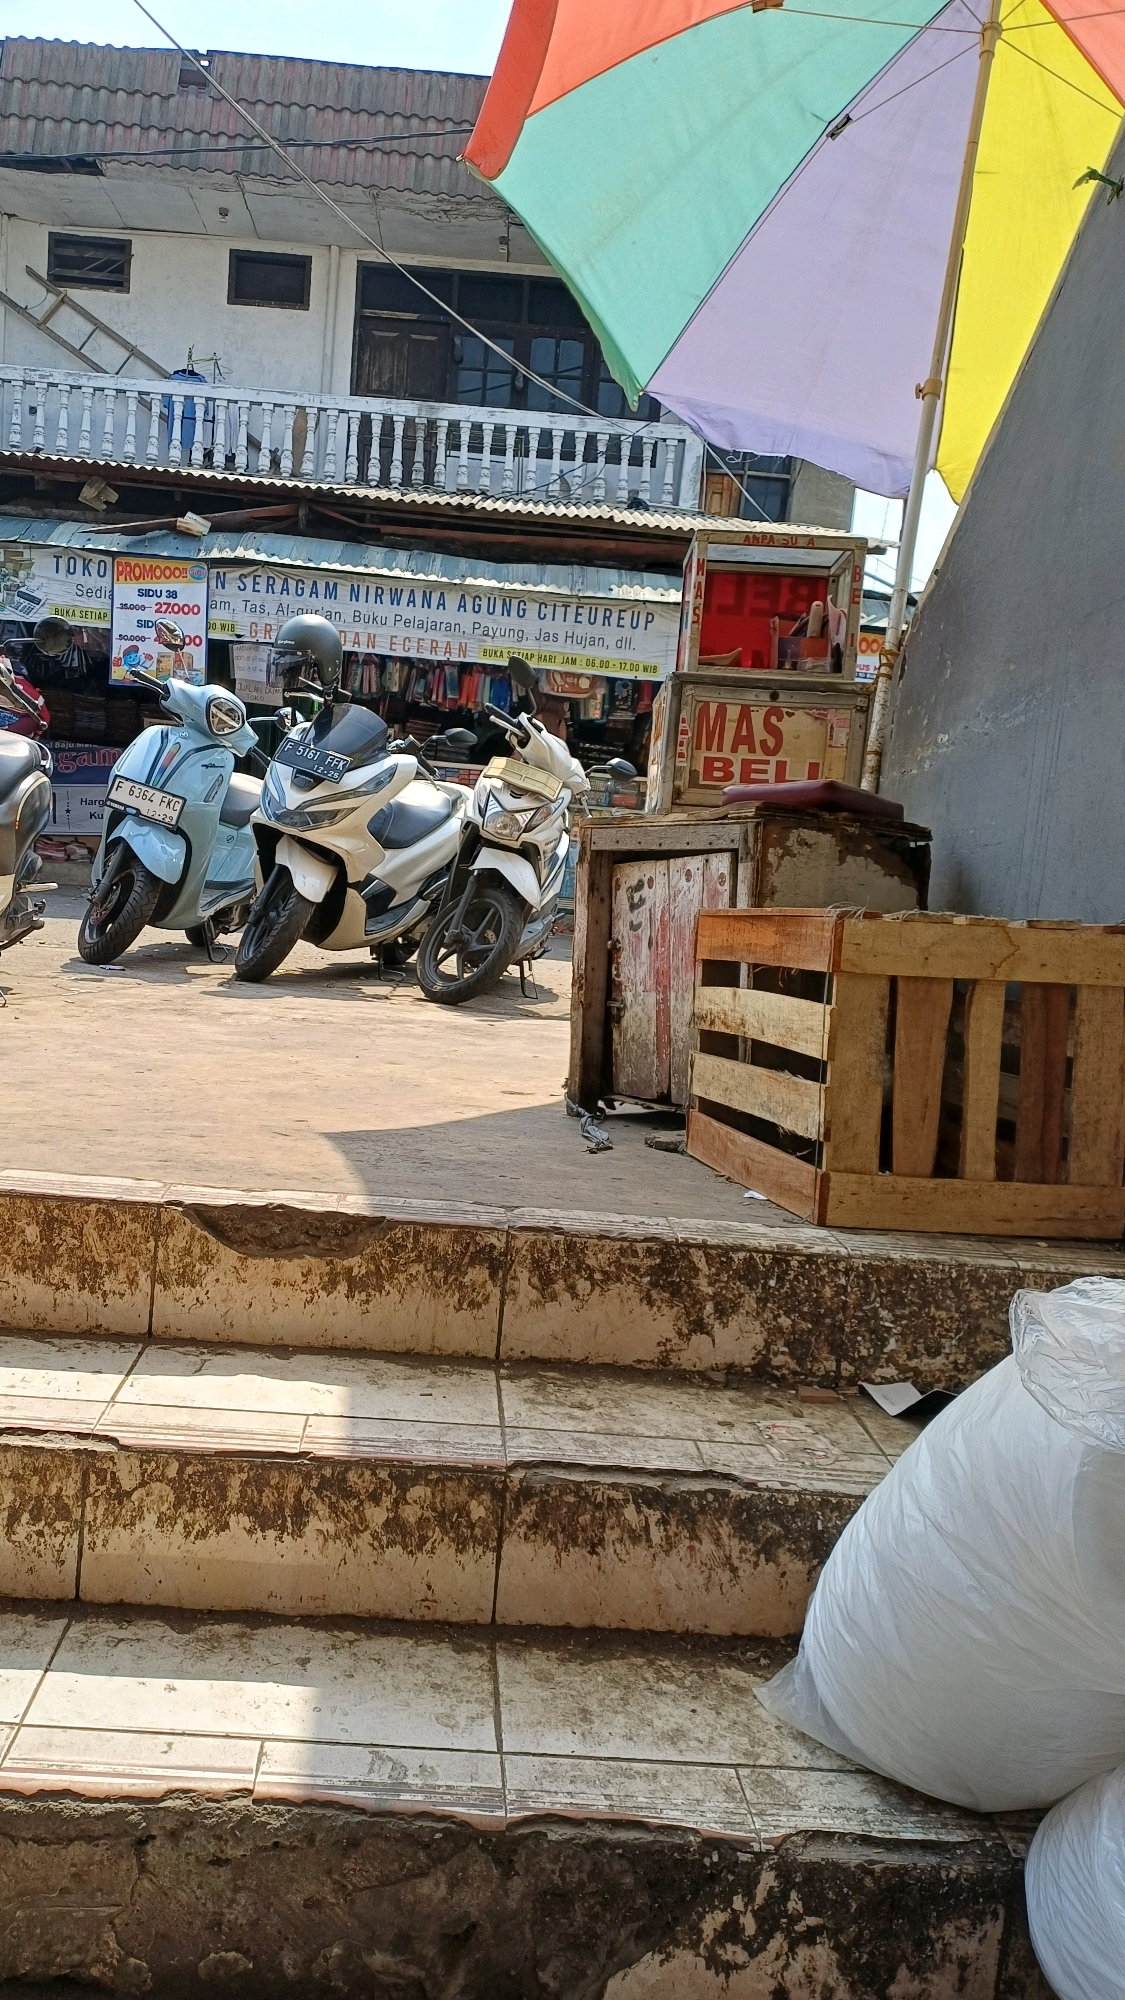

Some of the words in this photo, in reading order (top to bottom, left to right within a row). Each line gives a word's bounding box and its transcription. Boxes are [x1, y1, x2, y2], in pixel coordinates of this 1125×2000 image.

[53, 555, 107, 578] TOKO
[237, 573, 338, 601] SERAGAM
[350, 583, 446, 610] NIRWANA
[457, 593, 527, 619] AGUNG
[537, 601, 655, 631] CITEUREUP
[137, 588, 163, 598] SIDU
[165, 589, 178, 599] 38
[54, 607, 76, 618] BUKA
[79, 610, 108, 620] SETIAP
[119, 603, 146, 611] 35.000
[154, 601, 201, 616] 27.000
[220, 622, 236, 632] WIB
[242, 600, 270, 616] Tas,
[353, 610, 388, 626] Buku
[393, 614, 466, 635] Pelajaran,
[472, 621, 529, 642] Payung,
[534, 628, 559, 643] Jas
[565, 631, 609, 650] Hujan,
[615, 637, 636, 650] dll.
[338, 630, 376, 649] DAN
[389, 635, 468, 658] ECERAN
[482, 648, 504, 659] BUKA
[537, 652, 557, 664] HARI
[560, 655, 577, 666] JAM
[585, 658, 610, 669] 06.00
[619, 661, 640, 673] 17.00
[642, 664, 658, 674] WIB
[695, 701, 785, 756] MAS
[284, 742, 295, 752] F
[296, 745, 321, 761] 5161
[324, 755, 347, 771] FFK
[702, 756, 820, 784] BELI
[80, 798, 105, 809] Harg
[115, 781, 124, 792] F
[128, 785, 156, 803] 6364
[159, 795, 180, 812] FKC
